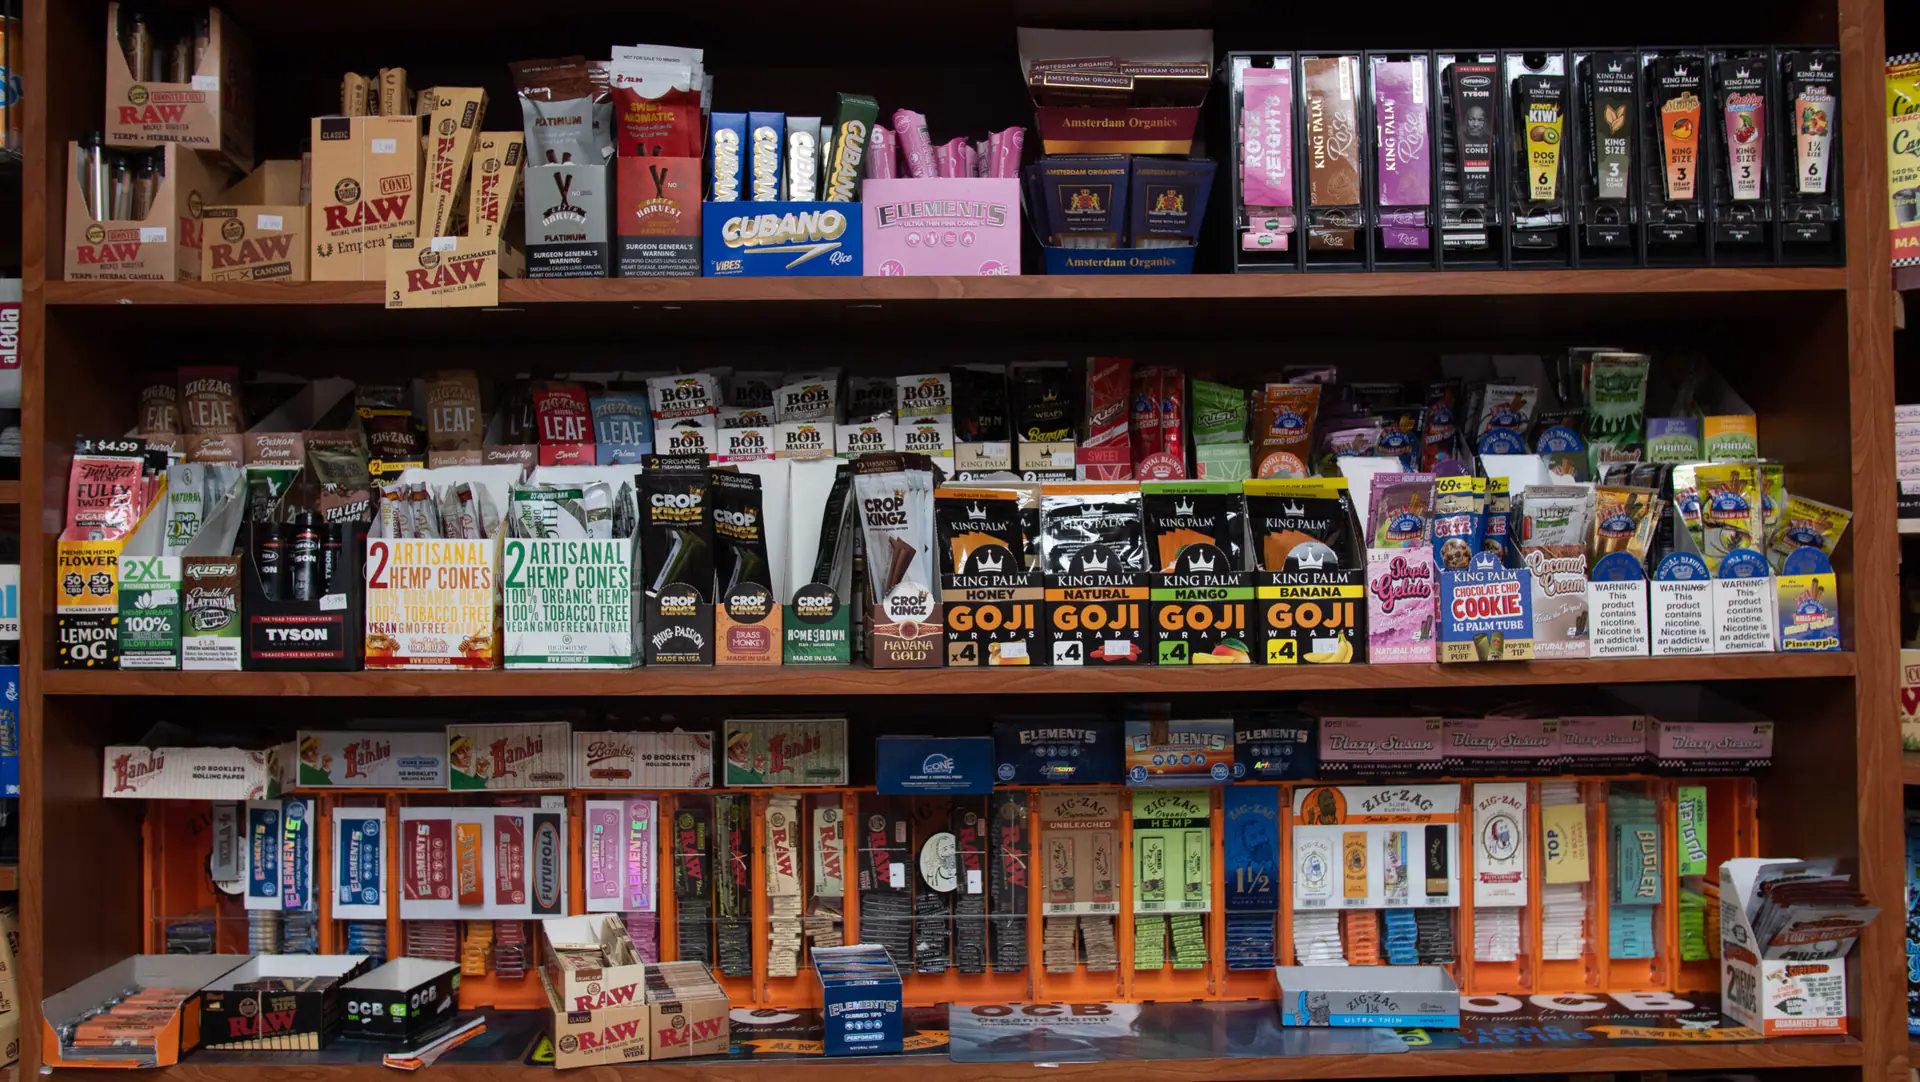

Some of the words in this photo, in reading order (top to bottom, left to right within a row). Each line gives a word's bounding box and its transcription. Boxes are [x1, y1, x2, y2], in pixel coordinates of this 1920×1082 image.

[118, 105, 187, 124] RAW
[1312, 99, 1323, 134] PALM
[1384, 101, 1395, 135] PALM
[1529, 110, 1556, 122] KIWI
[1063, 118, 1125, 128] Amsterdam
[1129, 117, 1177, 129] Organics
[146, 134, 178, 142] HERBAL
[322, 132, 349, 140] CLASSIC
[1245, 110, 1263, 168] ROSE
[1265, 95, 1285, 185] HEIGHTS
[1605, 138, 1625, 146] KING
[1315, 137, 1325, 169] KING
[1386, 138, 1396, 171] KING
[1609, 163, 1619, 176] 3
[383, 178, 409, 192] CONE
[1538, 172, 1548, 185] 6
[1892, 175, 1918, 183] HEMP
[324, 195, 410, 231] RAW
[877, 200, 1007, 228] ELEMENTS
[722, 210, 847, 248] CUBANO
[544, 234, 586, 242] PLATINUM
[77, 243, 142, 264] RAW
[210, 234, 293, 269] RAW
[448, 250, 496, 262] PEACEMAKER
[829, 251, 852, 266] Rice
[715, 260, 742, 271] VIBES
[1066, 257, 1126, 267] Amsterdam
[1130, 258, 1176, 268] Organics
[253, 264, 290, 277] CANNON
[406, 259, 485, 292] RAW
[393, 291, 400, 300] 3
[660, 384, 705, 402] BOB
[188, 400, 233, 426] LEAF
[545, 415, 587, 441] LEAF
[786, 431, 821, 444] BOB
[98, 440, 138, 452] $4.99
[262, 448, 290, 458] Cream
[488, 450, 518, 460] Straight
[519, 450, 532, 459] Up
[555, 451, 579, 460] Sweet
[1088, 451, 1119, 461] SWEET
[651, 493, 701, 508] CROP
[651, 507, 702, 520] KINGZ
[951, 522, 978, 530] KING
[980, 522, 1007, 531] PALM
[393, 542, 488, 565] ARTISANAL
[59, 557, 118, 566] FLOWER
[369, 541, 389, 589] 2
[1390, 556, 1430, 579] Purple
[1527, 551, 1585, 575] Coconut
[124, 557, 171, 582] 2XL
[390, 567, 432, 589] HEMP
[437, 567, 491, 589] CONES
[1164, 575, 1200, 586] KING
[1204, 574, 1239, 585] PALM
[1280, 588, 1341, 597] BANANA
[1371, 574, 1432, 614] Gelato
[1455, 584, 1499, 598] CHOCOLATE
[1501, 583, 1520, 593] CHIP
[1541, 577, 1585, 596] Cream
[1594, 583, 1640, 592] WARNING:
[505, 588, 537, 605] 100%
[542, 589, 592, 604] ORGANIC
[597, 589, 629, 604] HEMP
[966, 590, 1015, 600] HONEY
[1064, 589, 1129, 600] NATURAL
[1175, 590, 1228, 599] MANGO
[185, 593, 236, 612] PLATINUM
[1452, 594, 1521, 619] COOKIE
[1601, 601, 1634, 610] product
[543, 605, 596, 622] TOBACCO
[600, 605, 628, 621] FREE
[948, 604, 1034, 631] GOJI
[1600, 610, 1636, 618] contains
[125, 617, 171, 632] 100%
[1466, 622, 1493, 631] PALM
[1495, 620, 1523, 629] TUBE
[1600, 619, 1636, 627] nicotine.
[61, 628, 117, 644] LEMON
[265, 628, 328, 641] TYSON
[1606, 635, 1644, 644] addictive
[71, 641, 107, 660] OG
[732, 639, 764, 647] MONKEY
[884, 640, 933, 650] HAVANA
[1599, 645, 1639, 653] chemical.
[1785, 639, 1837, 648] Pineapple
[891, 650, 926, 661] GOLD
[1019, 728, 1097, 745] ELEMENTS
[1330, 734, 1376, 755] Blazy
[1378, 735, 1434, 749] Susan
[1143, 797, 1200, 816] ZIG-ZAG
[1362, 789, 1433, 812] ZIG-ZAG
[1479, 795, 1522, 811] ZIG-ZAG
[1050, 821, 1111, 829] UNBLEACHED
[1151, 819, 1192, 828] HEMP
[1547, 830, 1560, 860] TOP
[773, 828, 793, 878] RAW
[282, 816, 301, 908] ELEMENTS
[541, 829, 553, 901] FUTUROLA
[1635, 830, 1656, 898] BUGLER
[574, 983, 638, 1011] RAW
[348, 1001, 383, 1016] OCB
[829, 1000, 898, 1017] ELEMENTS
[229, 1011, 296, 1037] RAW
[1476, 1026, 1562, 1036] LONG
[578, 1019, 640, 1051] RAW
[658, 1017, 723, 1048] RAW
[1458, 1032, 1594, 1044] LASTING
[622, 1045, 645, 1053] SINGLE
[623, 1050, 645, 1059] WIDE
